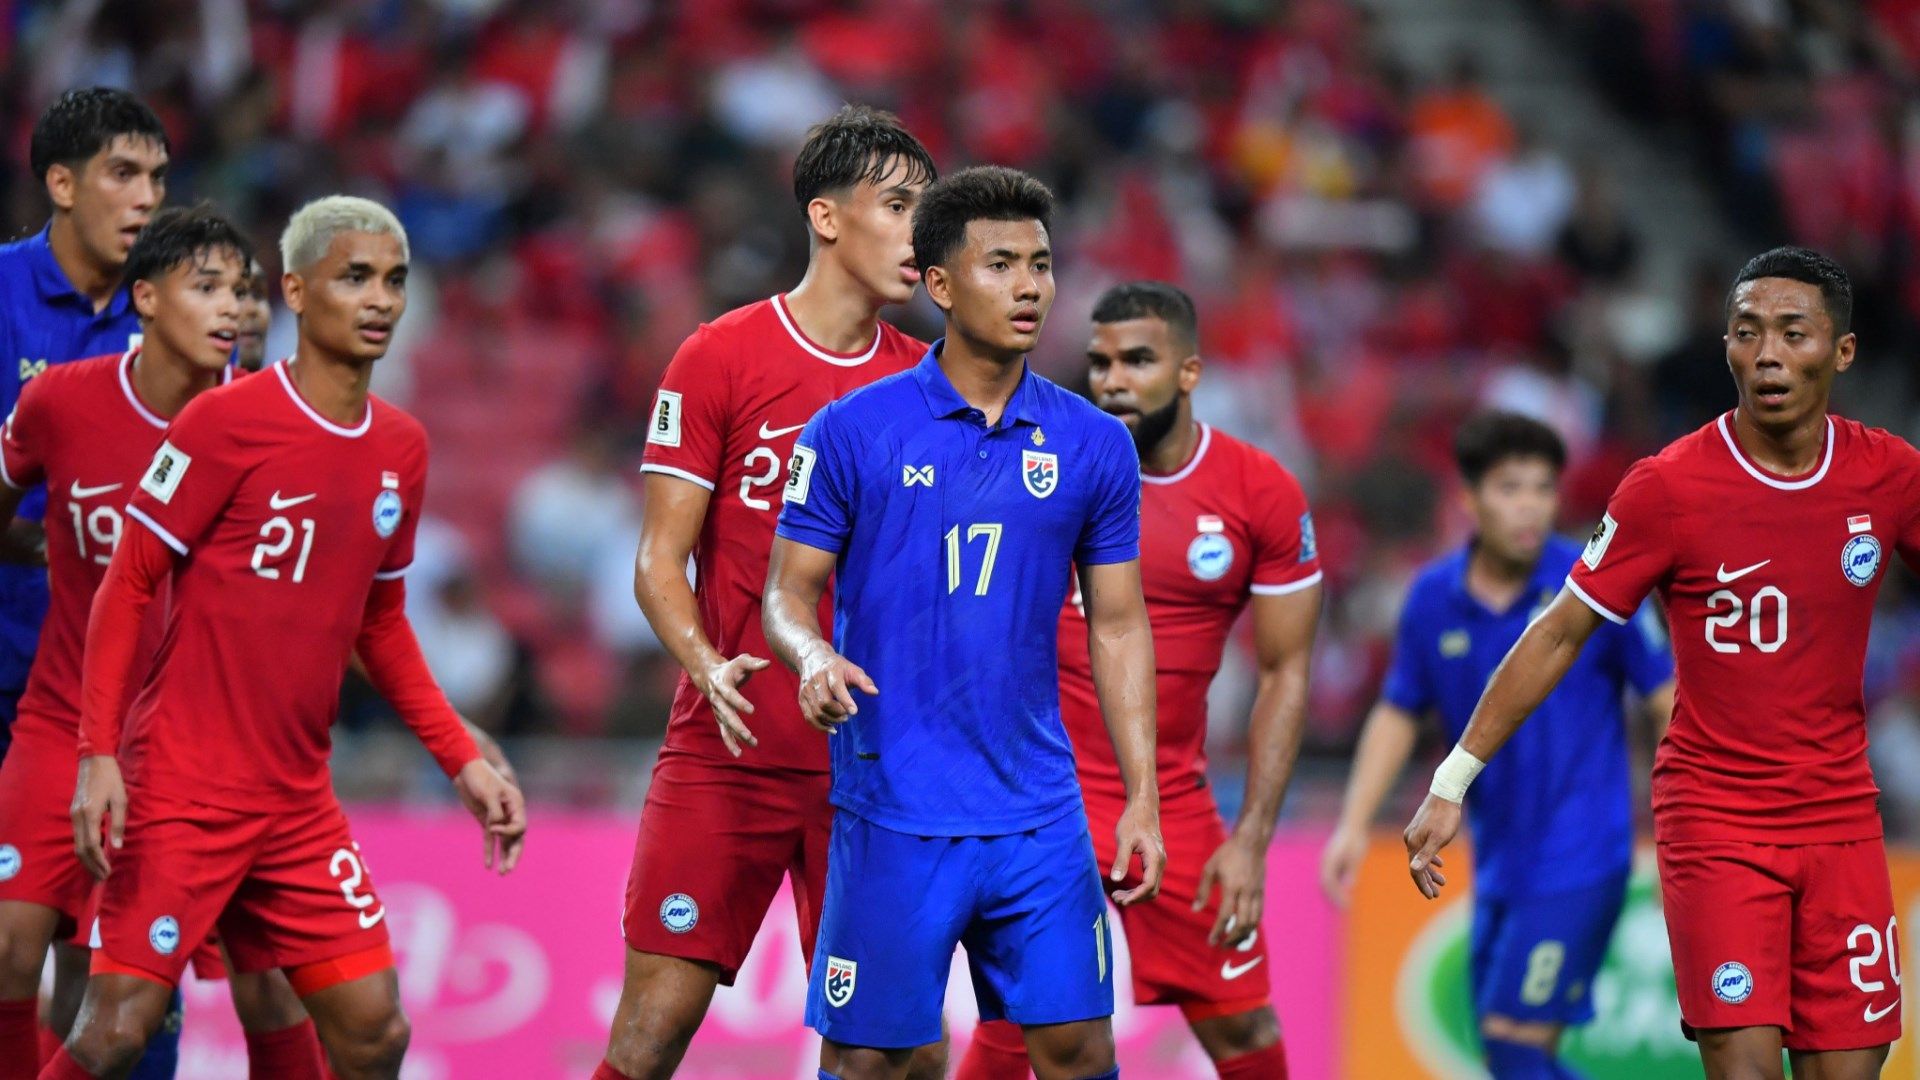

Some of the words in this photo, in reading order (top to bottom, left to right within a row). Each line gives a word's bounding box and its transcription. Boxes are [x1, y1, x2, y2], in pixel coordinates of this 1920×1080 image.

[739, 446, 794, 512] 2
[68, 502, 123, 565] 19
[251, 516, 316, 584] 21
[944, 523, 1003, 596] 17
[1705, 585, 1788, 654] 20
[329, 840, 375, 909] 2
[1092, 911, 1110, 985] 1
[1521, 940, 1565, 1007] 8
[1846, 914, 1900, 993] 20
